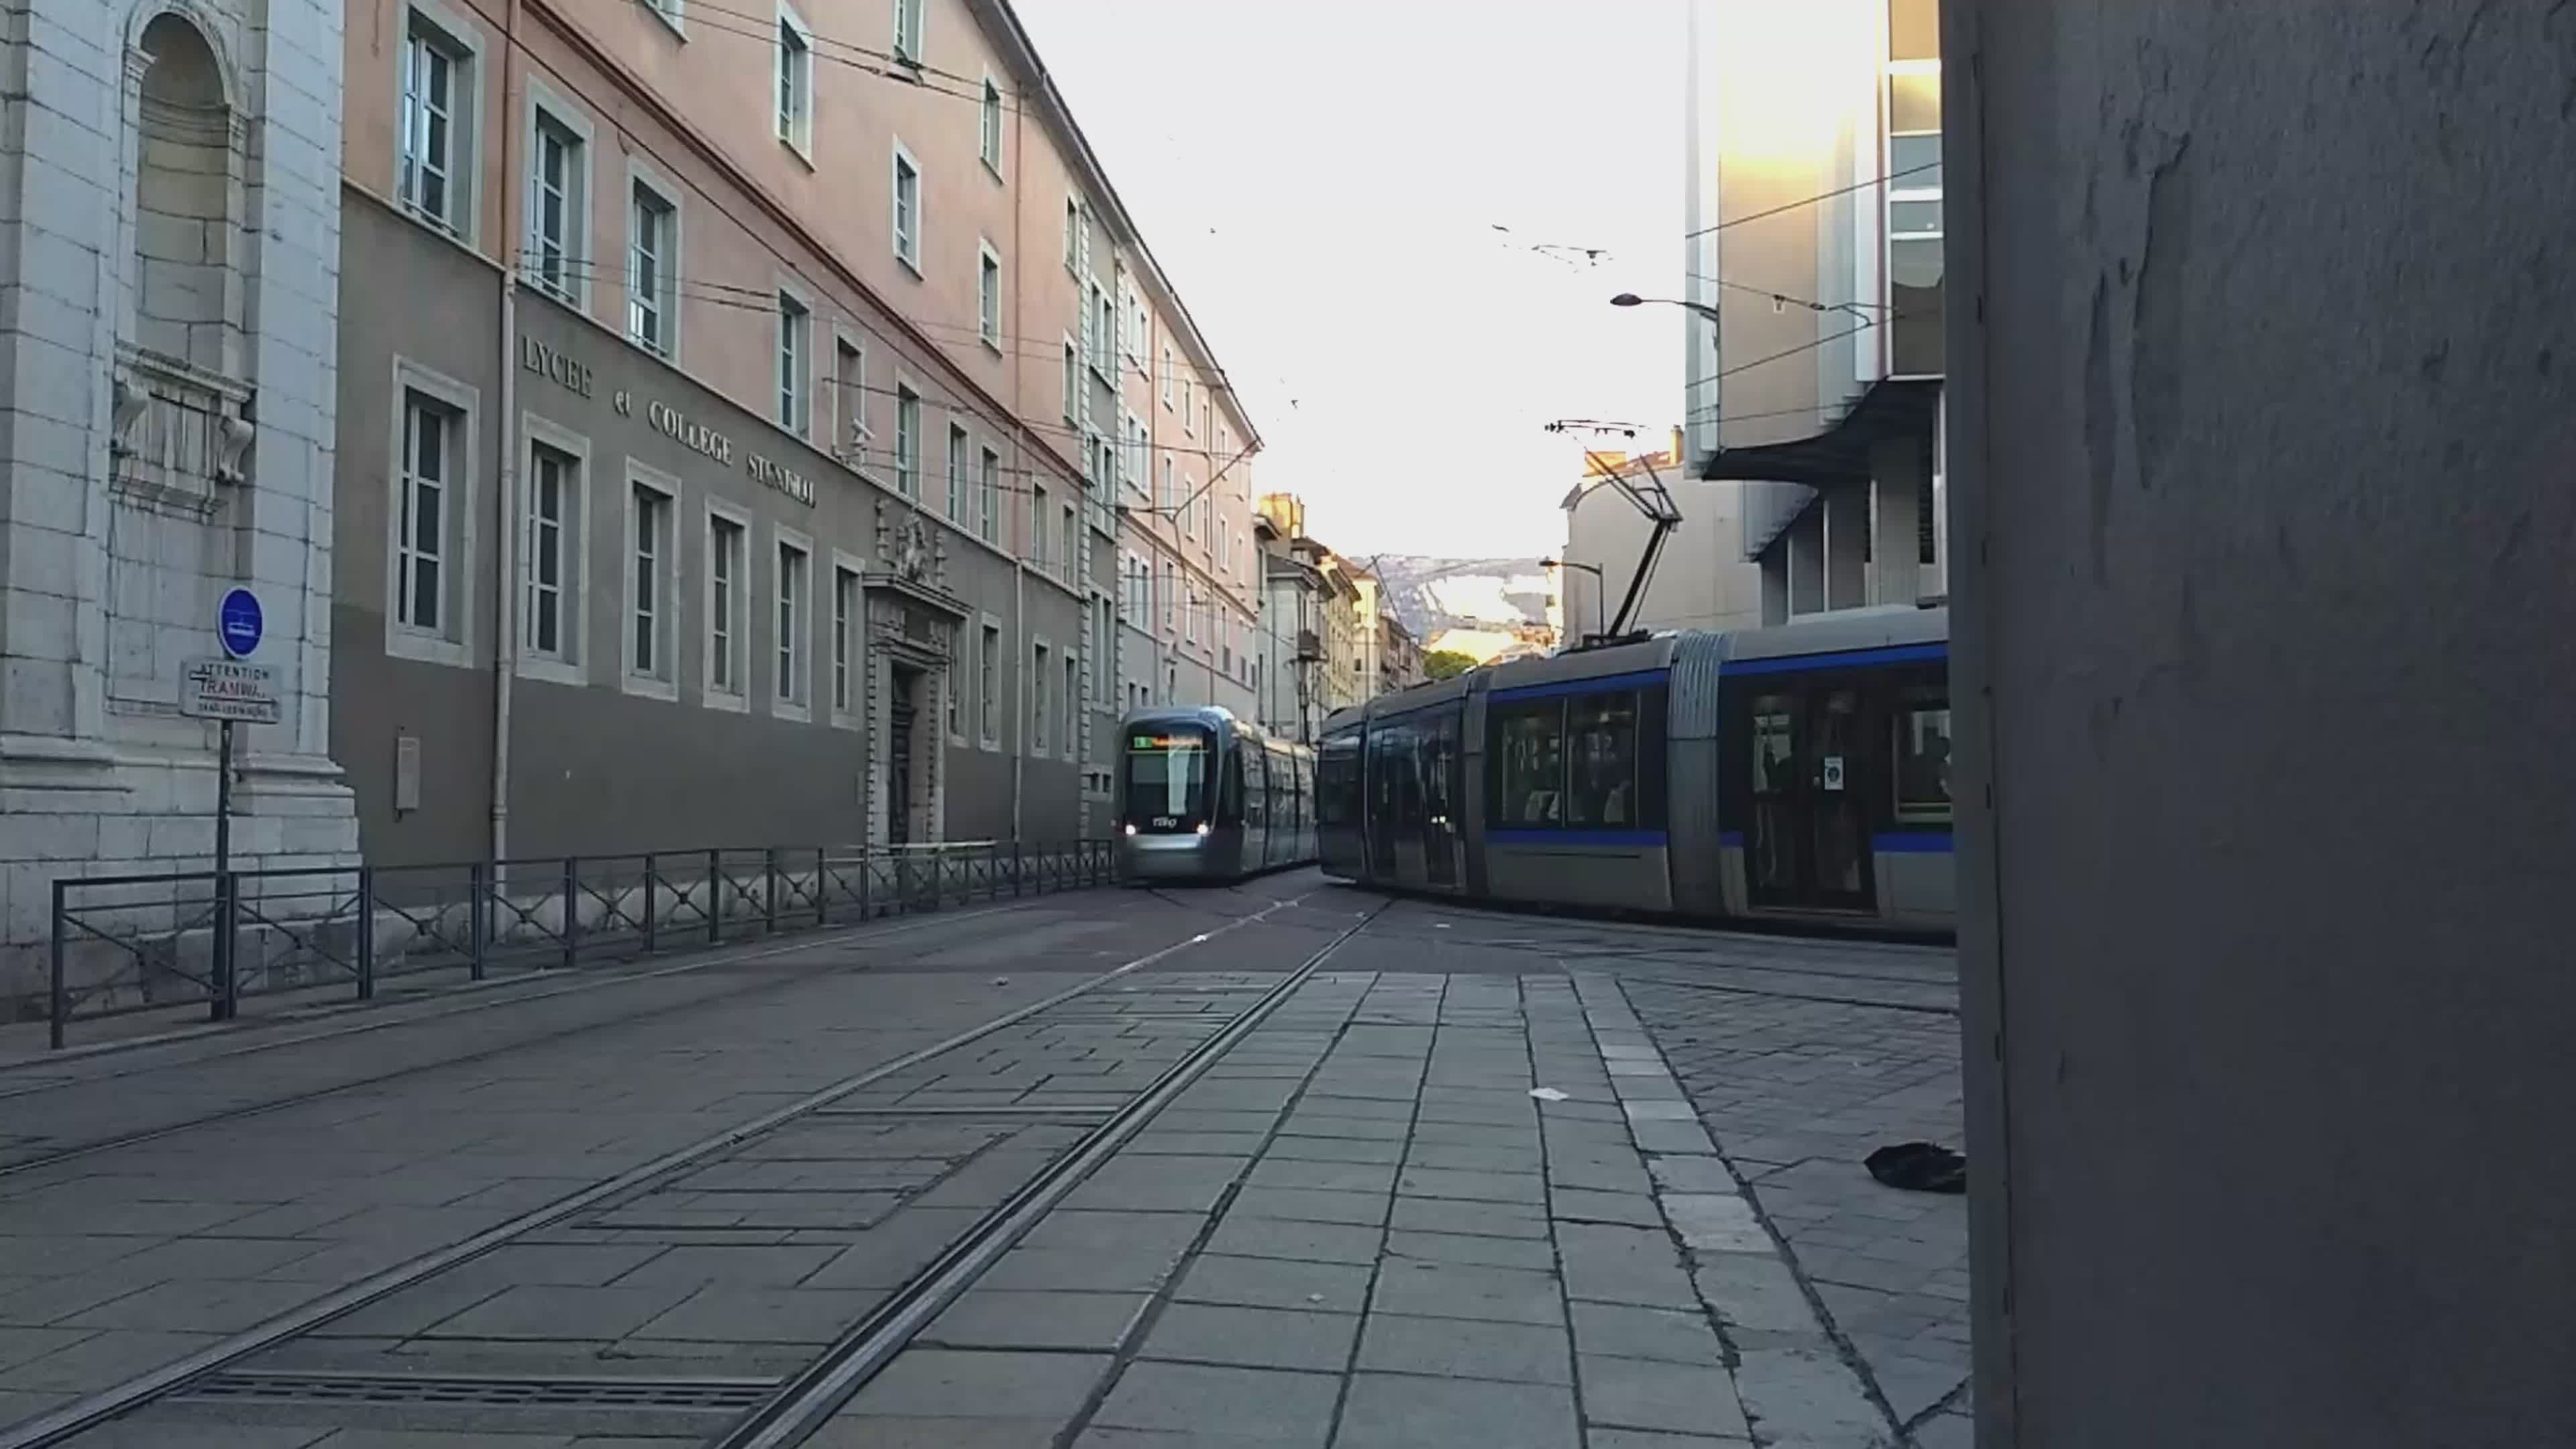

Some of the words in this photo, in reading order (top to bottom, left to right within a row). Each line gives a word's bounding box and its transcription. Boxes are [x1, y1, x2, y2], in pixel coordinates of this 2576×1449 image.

[523, 335, 593, 399] LYCEE
[614, 389, 631, 416] et
[648, 400, 733, 466] COLLEGE
[201, 663, 269, 680] ATTENTION
[201, 680, 266, 698] TRAMW
